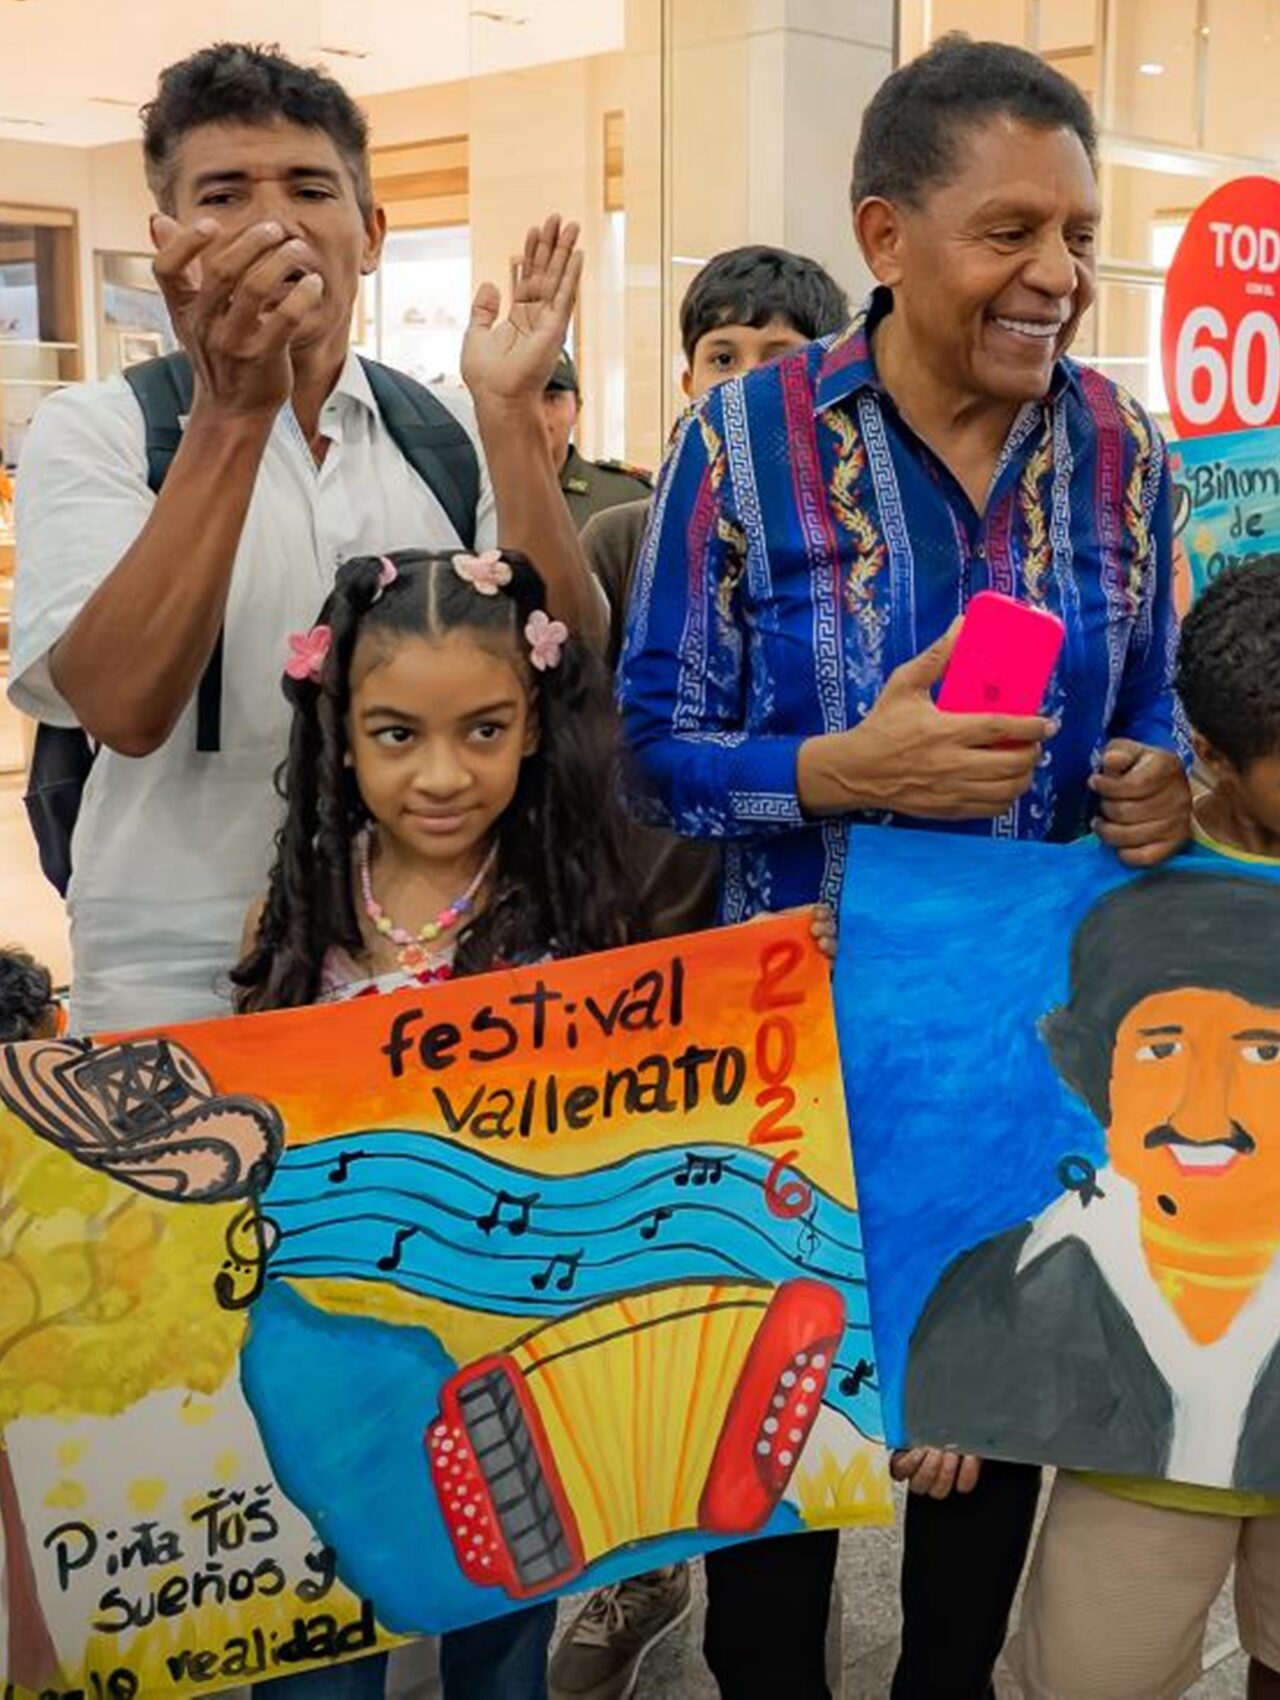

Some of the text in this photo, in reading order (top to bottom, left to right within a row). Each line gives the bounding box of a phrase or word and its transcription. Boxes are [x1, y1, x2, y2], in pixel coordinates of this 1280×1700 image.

[1229, 505, 1265, 539] de
[747, 940, 812, 1219] 2026
[295, 1545, 338, 1601] y
[167, 1598, 376, 1683] realidad
